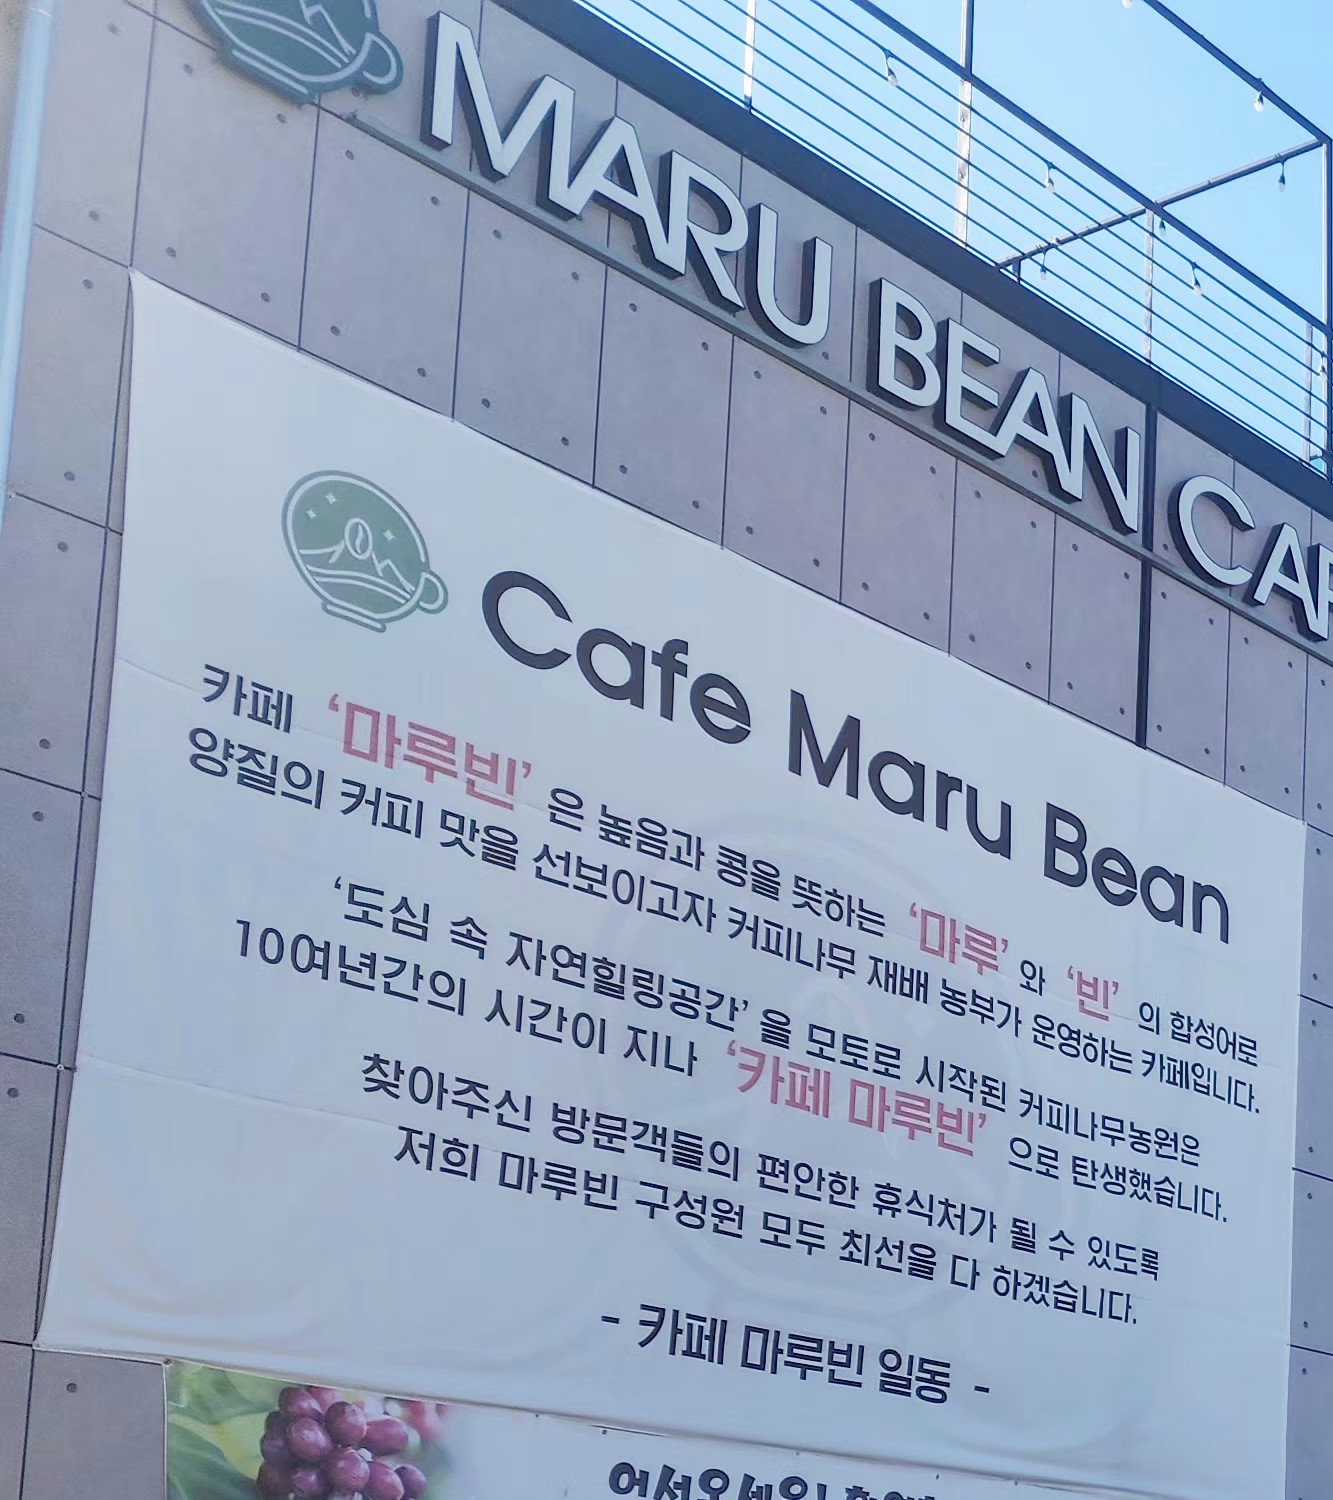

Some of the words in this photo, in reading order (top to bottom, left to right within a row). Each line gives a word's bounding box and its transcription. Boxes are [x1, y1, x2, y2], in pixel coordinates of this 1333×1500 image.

[420, 10, 833, 346] MARU
[868, 277, 1141, 535] BEAN
[201, 664, 293, 733] 카페
[547, 787, 584, 832] 은
[598, 804, 704, 871] 높음과
[716, 844, 781, 901] 콩을
[792, 874, 886, 937] 뜻하는
[1019, 959, 1046, 996] 와
[1138, 1002, 1160, 1035] 의
[1169, 1010, 1258, 1068] 합성어로
[481, 570, 752, 745] Cafe
[787, 688, 1012, 861] Maru
[1043, 801, 1231, 945] Bean
[188, 727, 325, 810] 양질의
[340, 777, 423, 839] 커피
[440, 808, 520, 871] 맛을
[532, 844, 716, 934] 선보이고자
[727, 905, 856, 979] 커피나무
[866, 954, 929, 1005] 재배
[939, 977, 1022, 1038] 농부가
[1031, 1013, 1133, 1075] 운영하는
[1141, 1049, 1260, 1114] 카페입니다.
[236, 919, 466, 1017] 10여년간의
[484, 989, 607, 1056] 시간이
[623, 1024, 699, 1077] 지나
[1008, 1136, 1060, 1182] 으로
[1070, 1155, 1228, 1224] 탄생했습니다.
[449, 916, 488, 960] 속
[760, 1007, 792, 1050] 을
[806, 1023, 901, 1081] 모토로
[915, 1055, 1006, 1113] 시작된
[1019, 1088, 1201, 1168] 커피나무농원은
[361, 1052, 532, 1133] 찾아주신
[551, 1101, 740, 1182] 방문객들의
[757, 1152, 859, 1210] 편안한
[872, 1181, 997, 1244] 휴식처가
[1009, 1217, 1037, 1255] 될
[1048, 1230, 1075, 1262] 수
[1086, 1235, 1160, 1282] 있도록
[393, 1125, 479, 1182] 저희
[498, 1151, 619, 1211] 마루빈
[634, 1179, 745, 1240] 구성원
[759, 1211, 825, 1256] 모두
[838, 1228, 937, 1281] 최선을
[949, 1254, 980, 1291] 다
[992, 1265, 1137, 1325] 하겠습니다.
[637, 1303, 727, 1366] 카페
[740, 1324, 865, 1388] 마루빈
[877, 1348, 952, 1405] 일동
